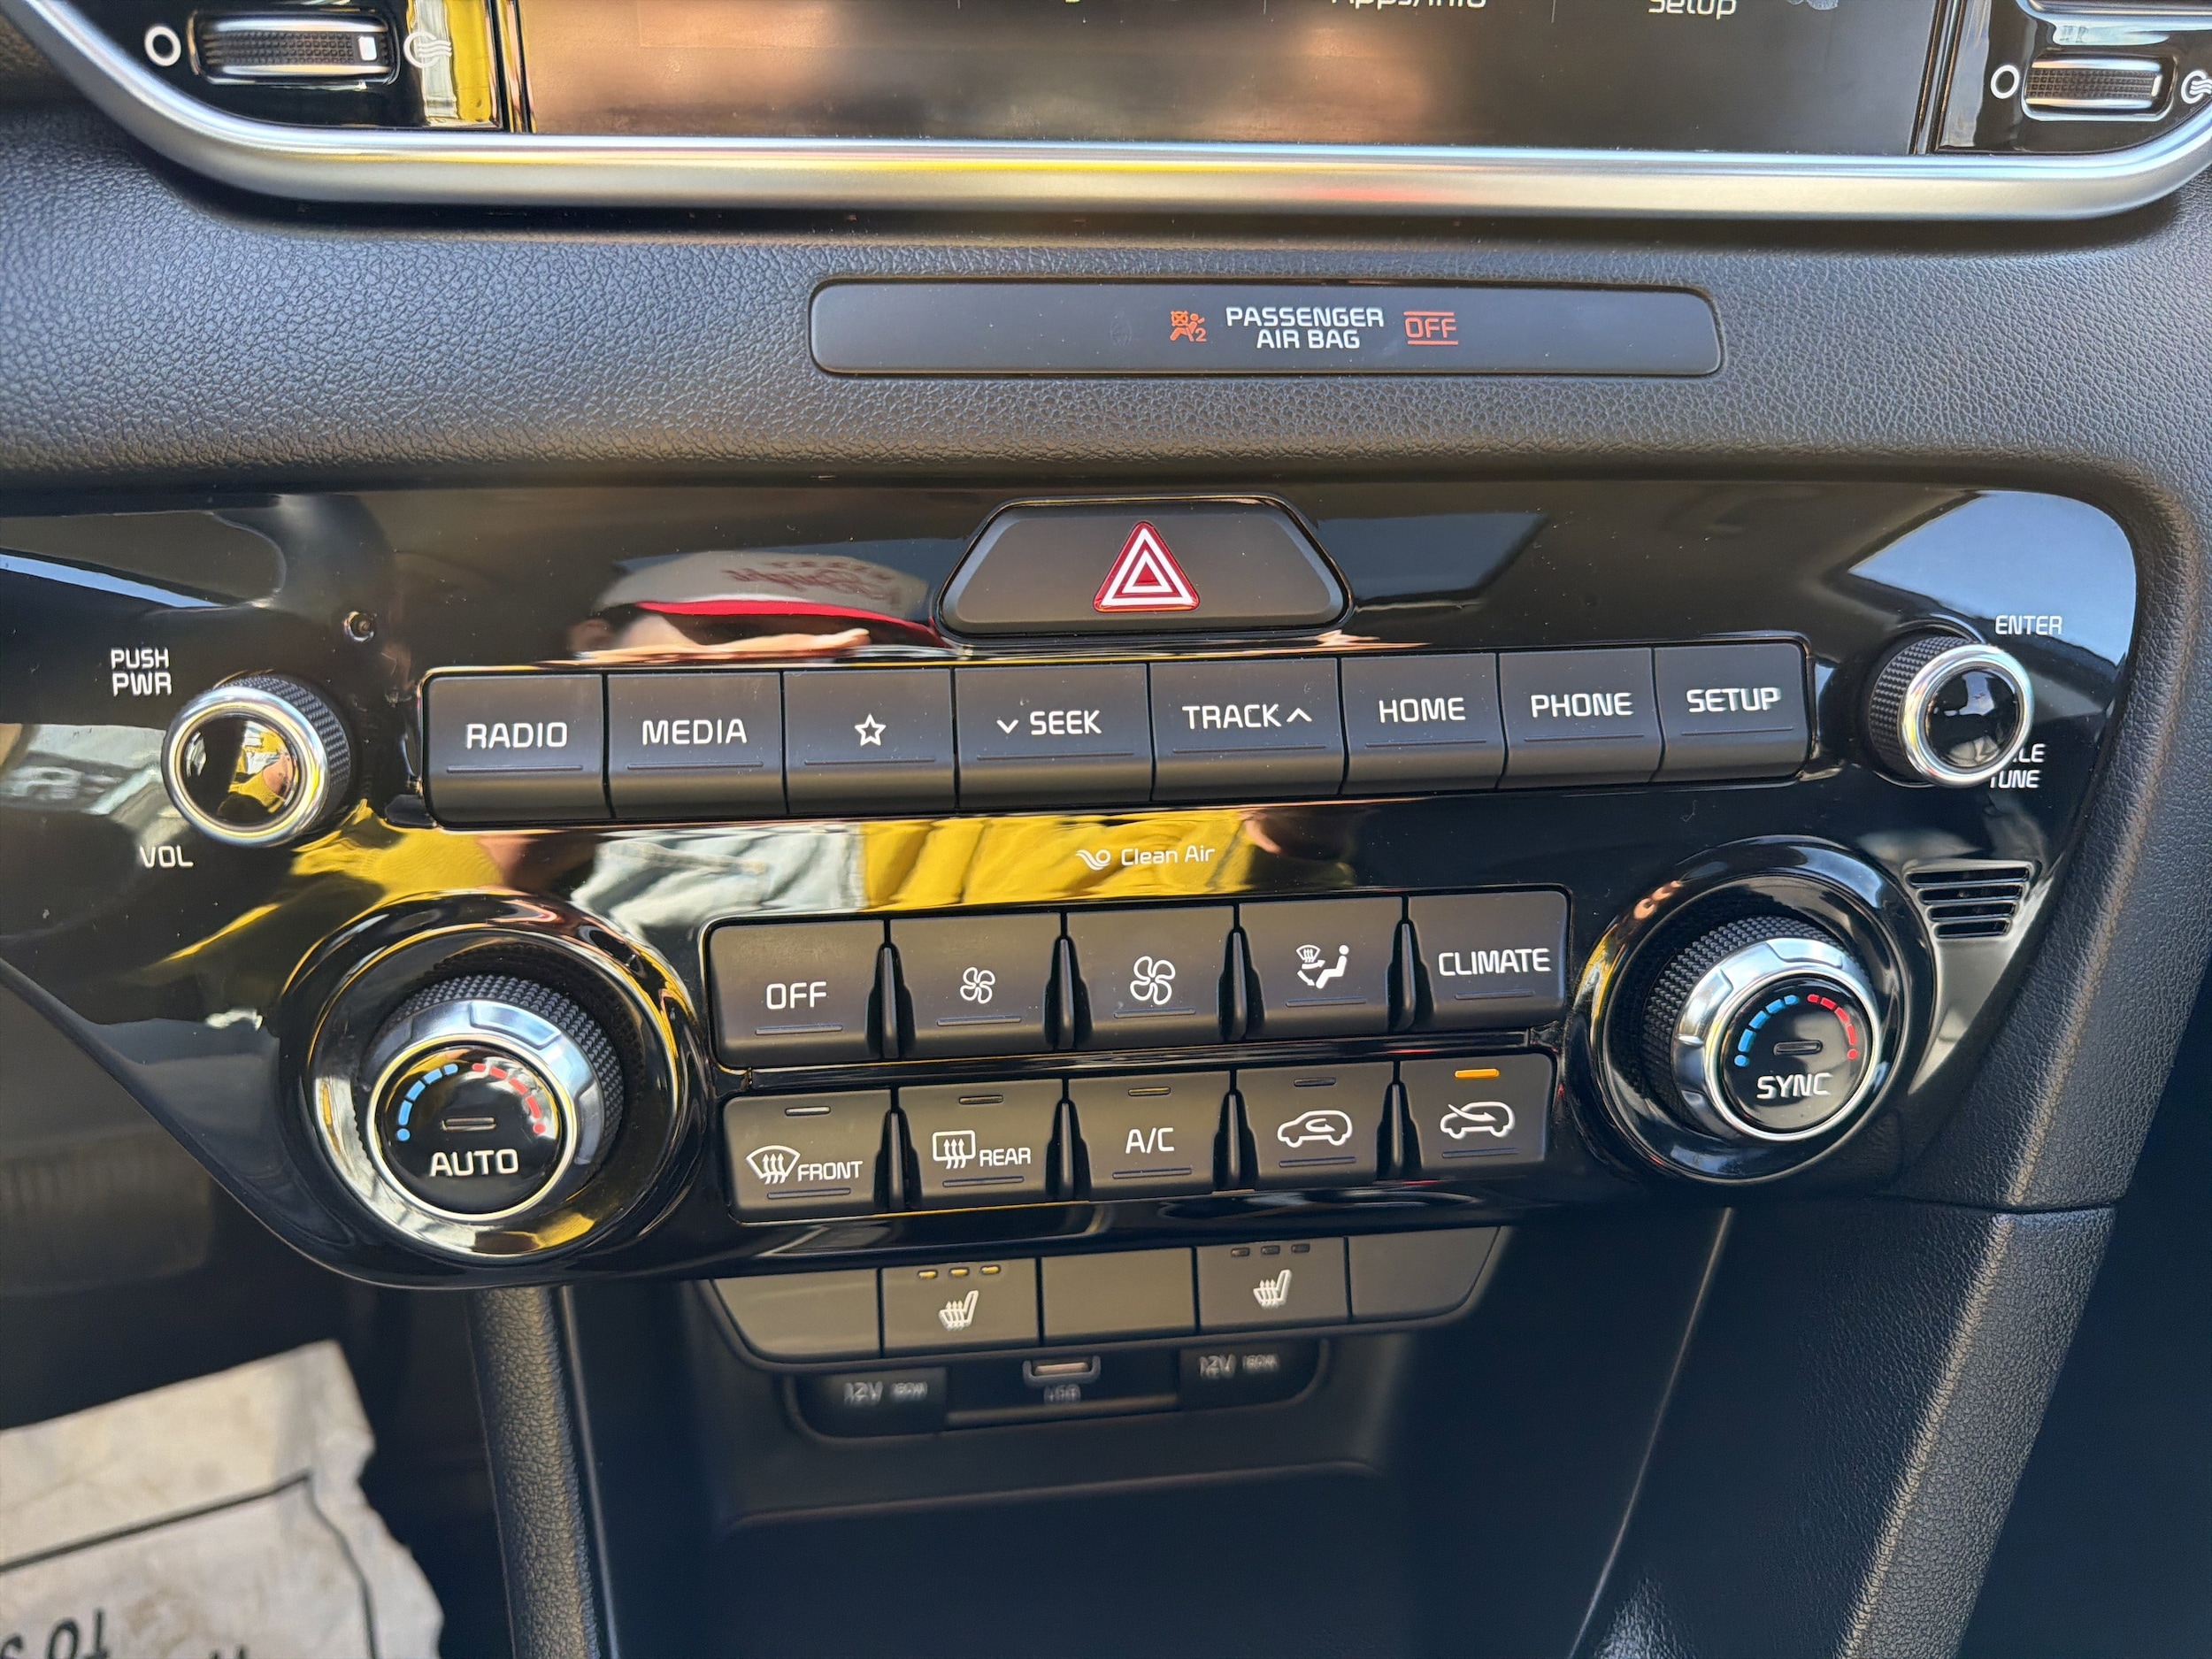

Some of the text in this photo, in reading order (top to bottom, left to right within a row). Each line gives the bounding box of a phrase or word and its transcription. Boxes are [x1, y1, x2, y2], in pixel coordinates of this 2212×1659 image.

[1648, 0, 1737, 19] Setup
[1225, 306, 1385, 328] PASSENGER
[1403, 318, 1457, 339] OFF
[1256, 329, 1360, 349] AIR BAG
[1994, 614, 2062, 635] ENTER
[110, 648, 170, 670] PUSH
[111, 671, 173, 696] PWR
[1378, 696, 1466, 723] HOME
[1530, 692, 1634, 718] PHONE
[1686, 687, 1782, 713] SETUP
[1029, 710, 1102, 735] SEEK
[1181, 703, 1282, 730] TRACK
[465, 721, 568, 749] RADIO
[641, 718, 748, 746] MEDIA
[139, 845, 195, 868] VOL
[1121, 844, 1216, 866] Clean Air
[1438, 948, 1551, 977] CLIMATE
[765, 981, 827, 1010] OFF
[1756, 1072, 1833, 1099] SYNC
[1125, 1126, 1175, 1154] A/C
[428, 1148, 519, 1178] AUTO
[979, 1147, 1032, 1167] REAR
[797, 1161, 864, 1182] FRONT
[1199, 1354, 1236, 1378] 12V
[843, 1381, 884, 1405] 12V
